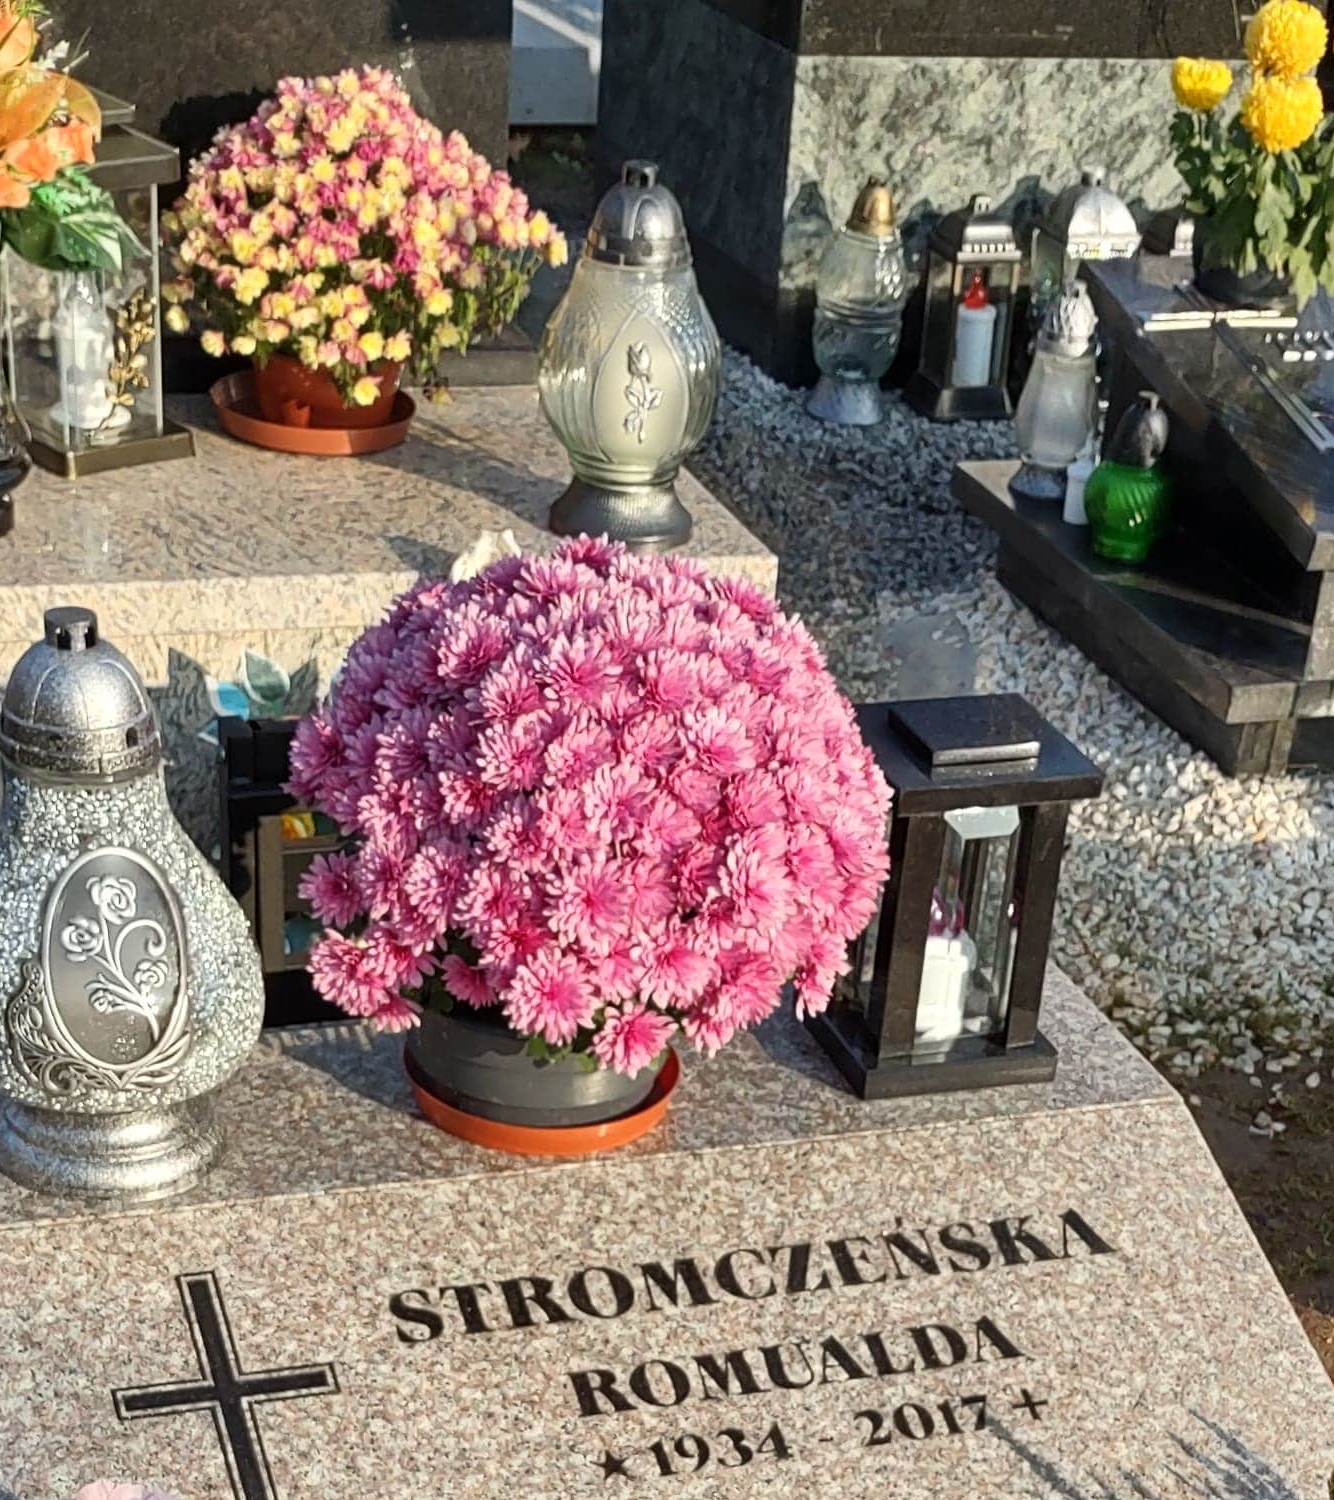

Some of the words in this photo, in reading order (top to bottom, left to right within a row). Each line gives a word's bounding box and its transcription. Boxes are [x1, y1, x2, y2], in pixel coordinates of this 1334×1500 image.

[388, 1207, 1118, 1344] STROMCZEŃSKA
[568, 1315, 1033, 1418] ROMUALDA
[647, 1420, 795, 1477] 1934
